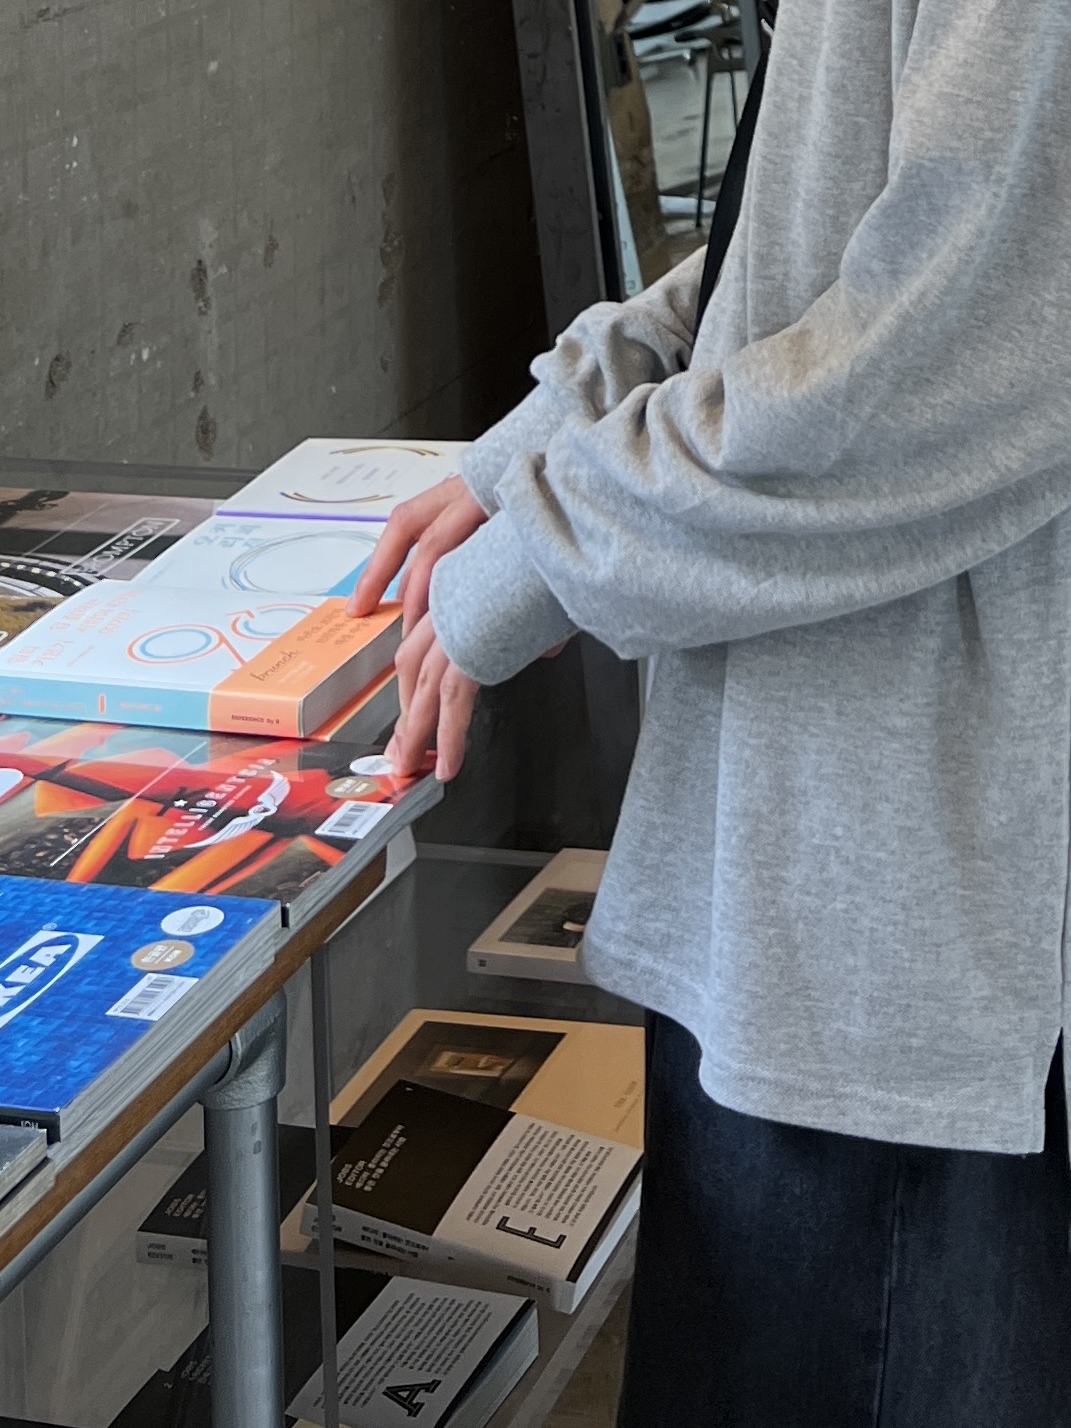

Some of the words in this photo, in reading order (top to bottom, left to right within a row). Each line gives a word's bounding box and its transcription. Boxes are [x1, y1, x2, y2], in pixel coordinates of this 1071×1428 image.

[0, 944, 72, 1007] KEA
[345, 1160, 367, 1186] EDITOR
[382, 1379, 442, 1418] A
